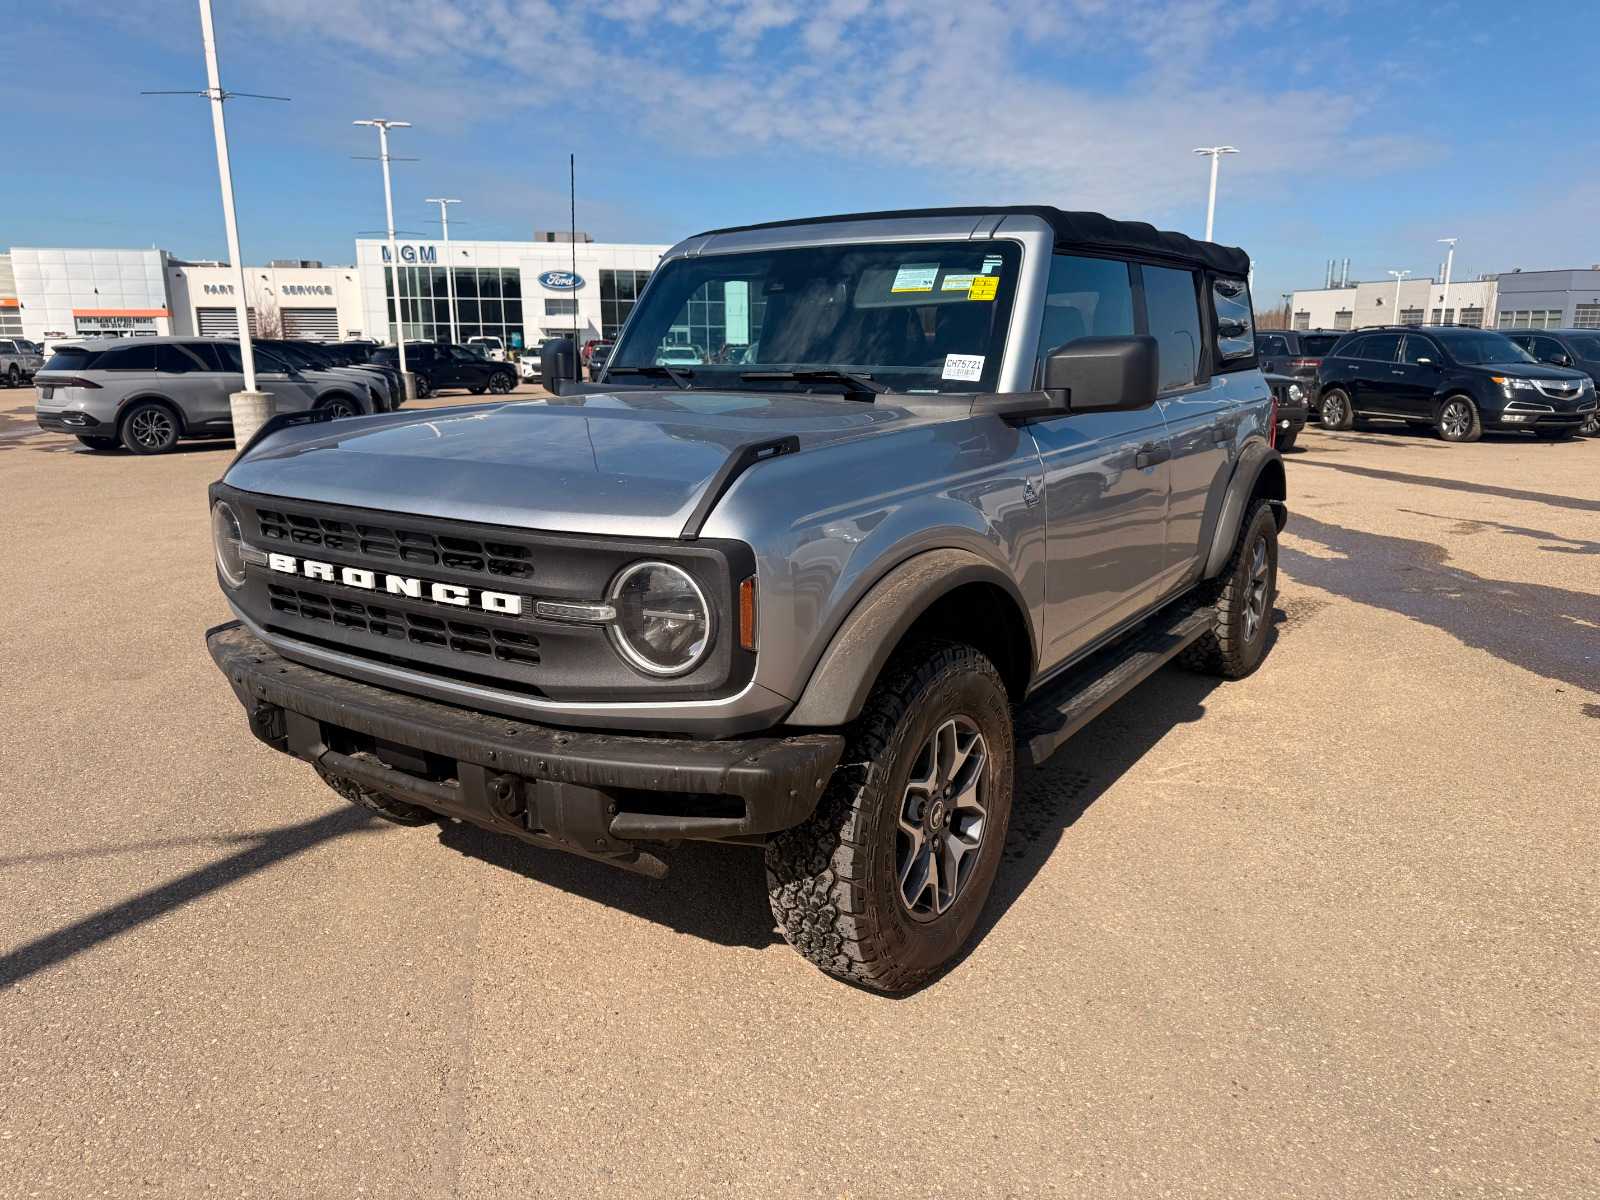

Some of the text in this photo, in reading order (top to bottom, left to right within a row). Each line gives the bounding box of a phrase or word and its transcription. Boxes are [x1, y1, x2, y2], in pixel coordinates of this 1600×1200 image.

[546, 272, 576, 286] Ford
[203, 284, 235, 295] PART
[281, 285, 333, 296] SERVICE
[268, 552, 522, 615] BRONCO
